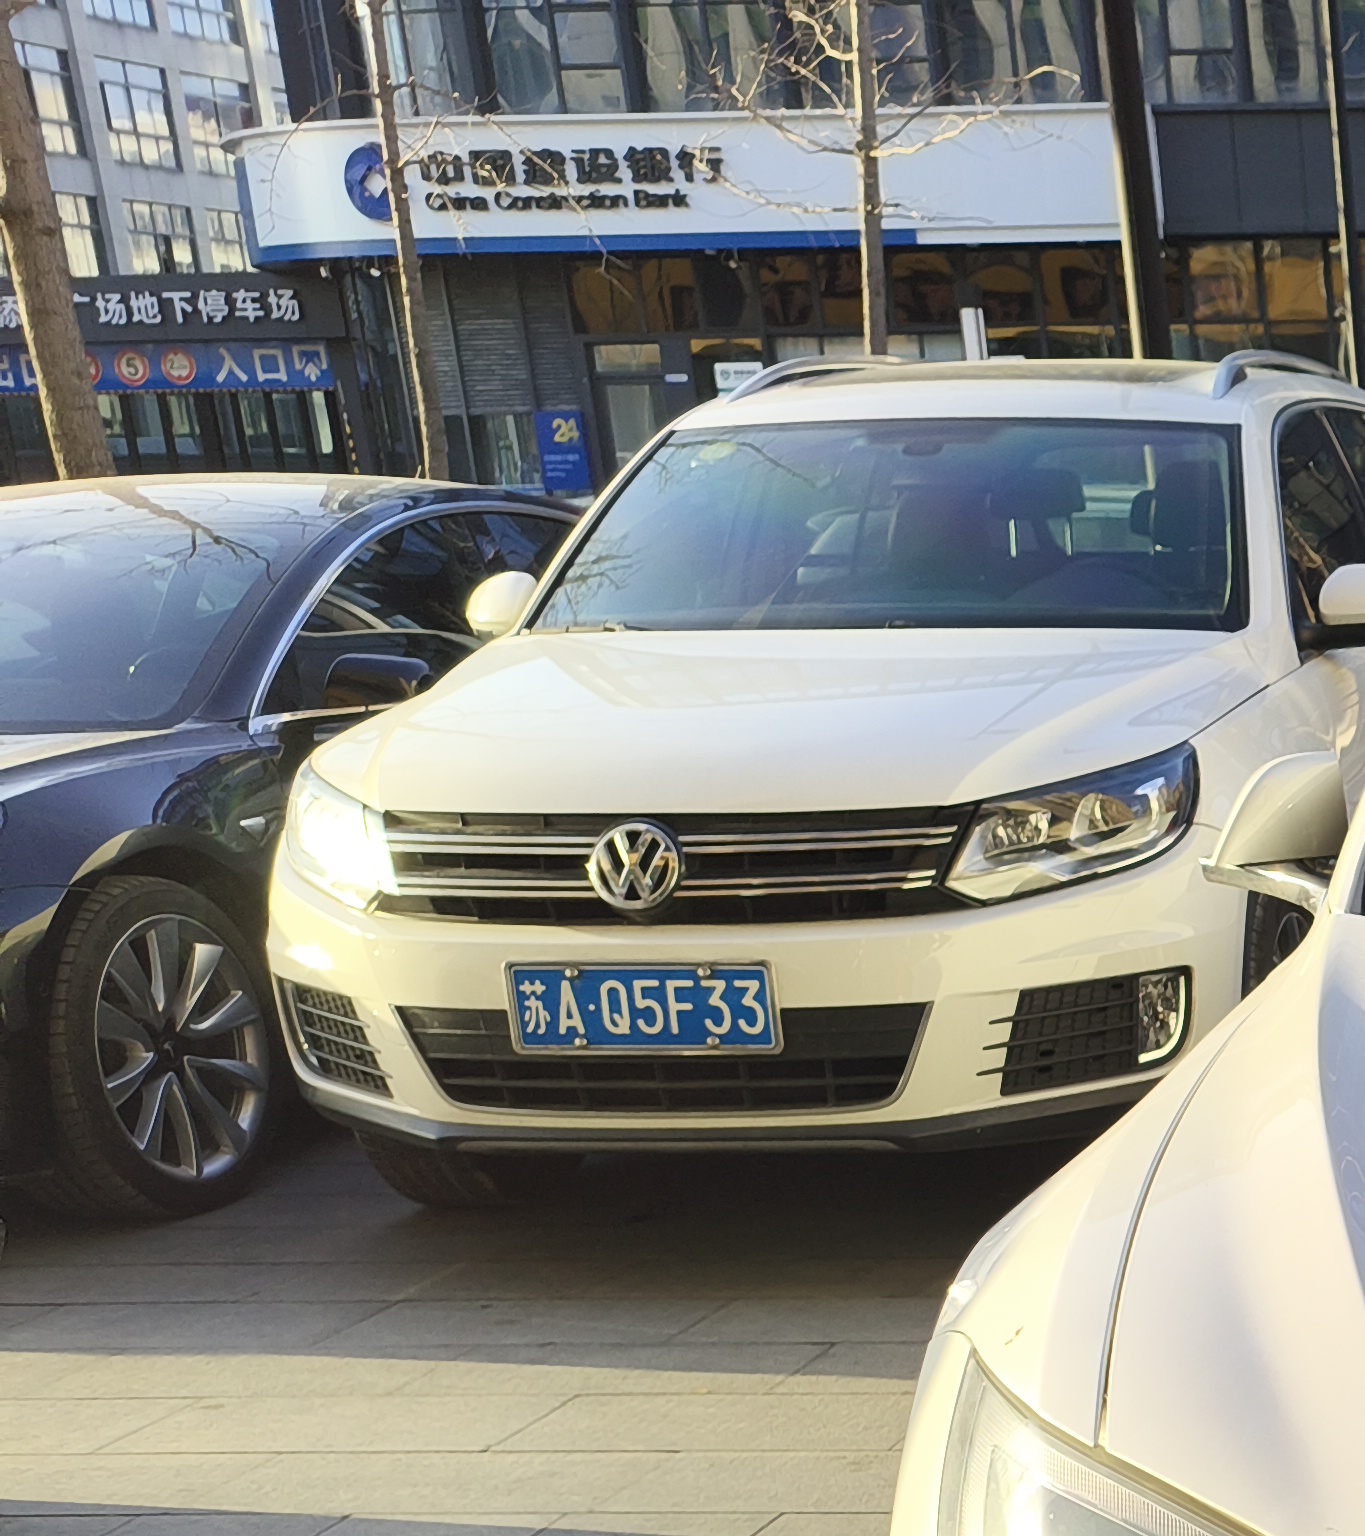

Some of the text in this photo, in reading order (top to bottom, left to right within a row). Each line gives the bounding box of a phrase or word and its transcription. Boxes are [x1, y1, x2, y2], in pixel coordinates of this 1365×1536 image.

[418, 146, 724, 185] 中国建设银行
[633, 189, 690, 209] Bank
[125, 356, 140, 376] 5
[216, 347, 288, 383] 入口
[518, 979, 766, 1036] 苏A·Q5F33
